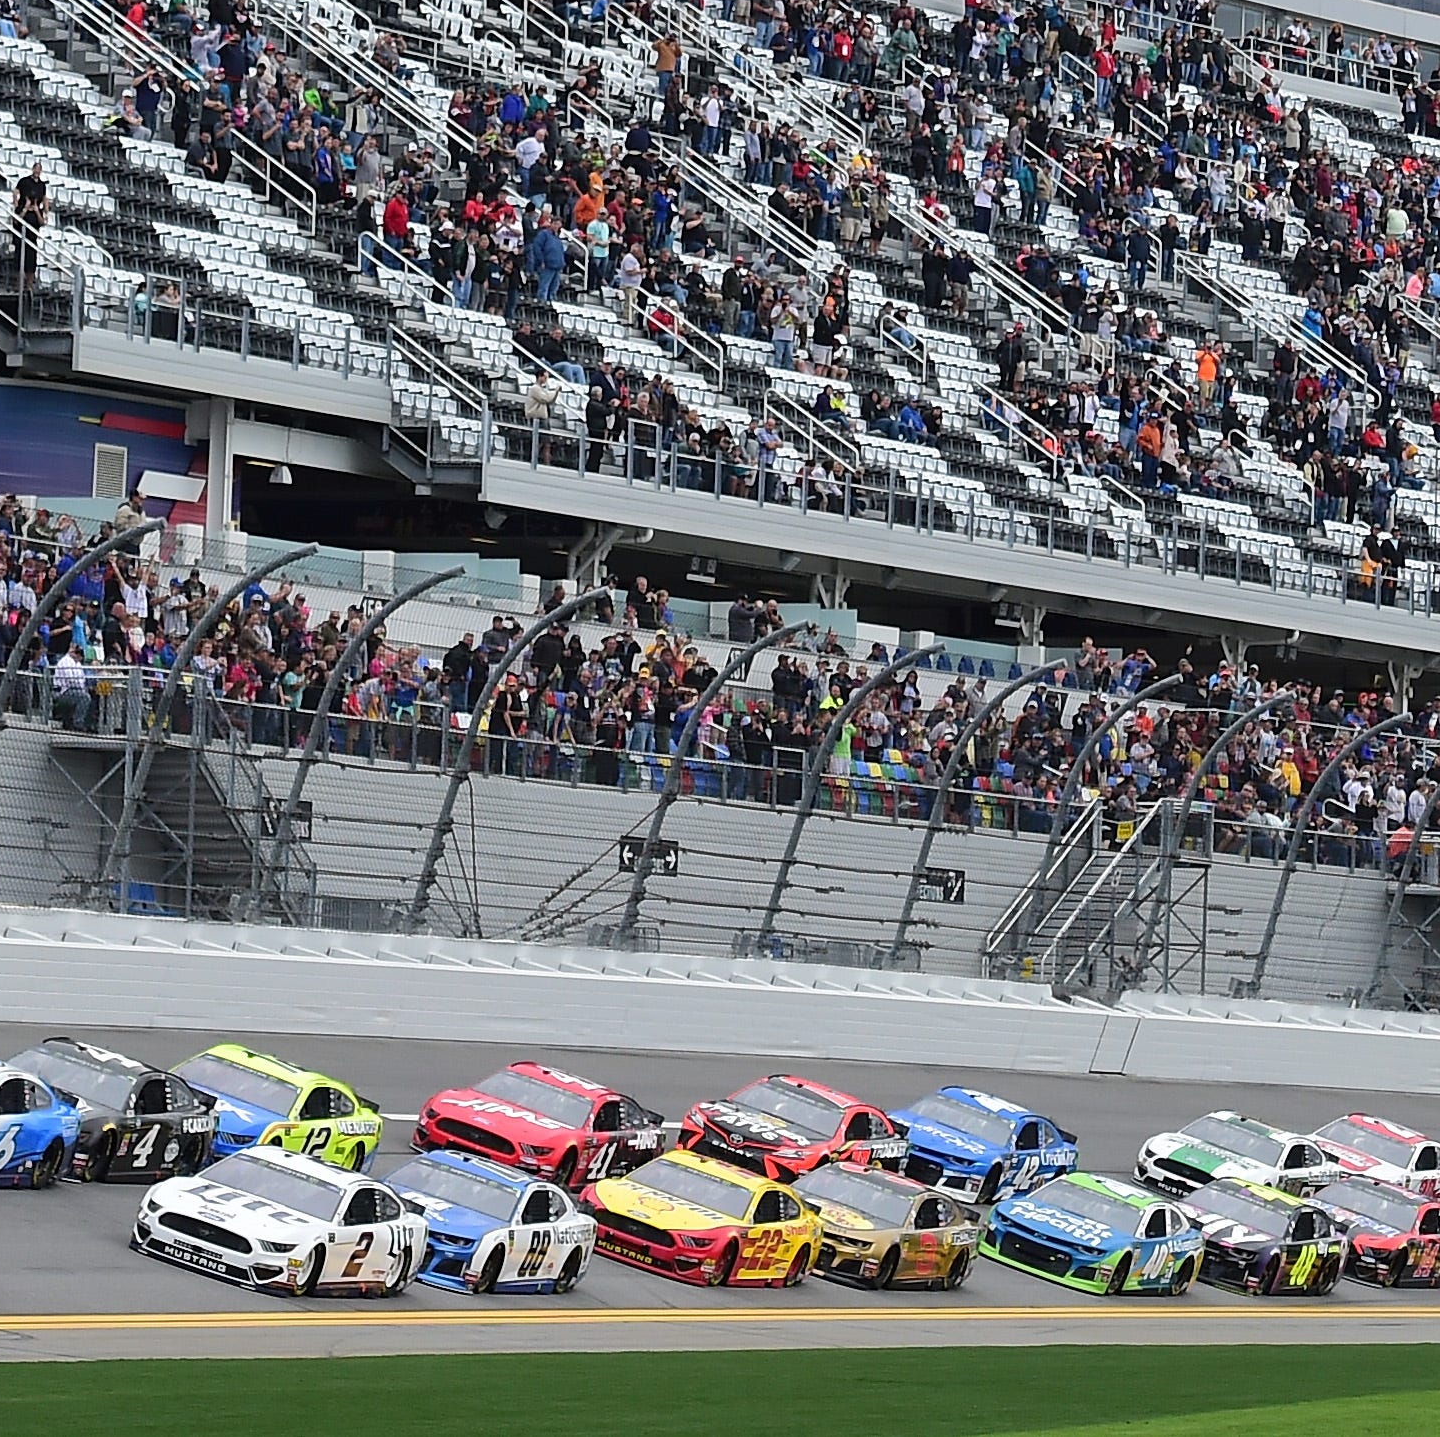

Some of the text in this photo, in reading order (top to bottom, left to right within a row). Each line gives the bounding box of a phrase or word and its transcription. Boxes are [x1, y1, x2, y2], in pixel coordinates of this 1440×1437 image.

[131, 1123, 162, 1168] 4
[300, 1127, 332, 1160] 12
[587, 1142, 618, 1180] 41
[1009, 1155, 1040, 1191] 42
[1009, 1206, 1103, 1247] Health
[1011, 1200, 1114, 1239] Advent
[163, 1244, 227, 1274] MUSTANG
[340, 1231, 375, 1278] 2
[597, 1238, 654, 1265] MUSTANG
[746, 1229, 784, 1271] 22
